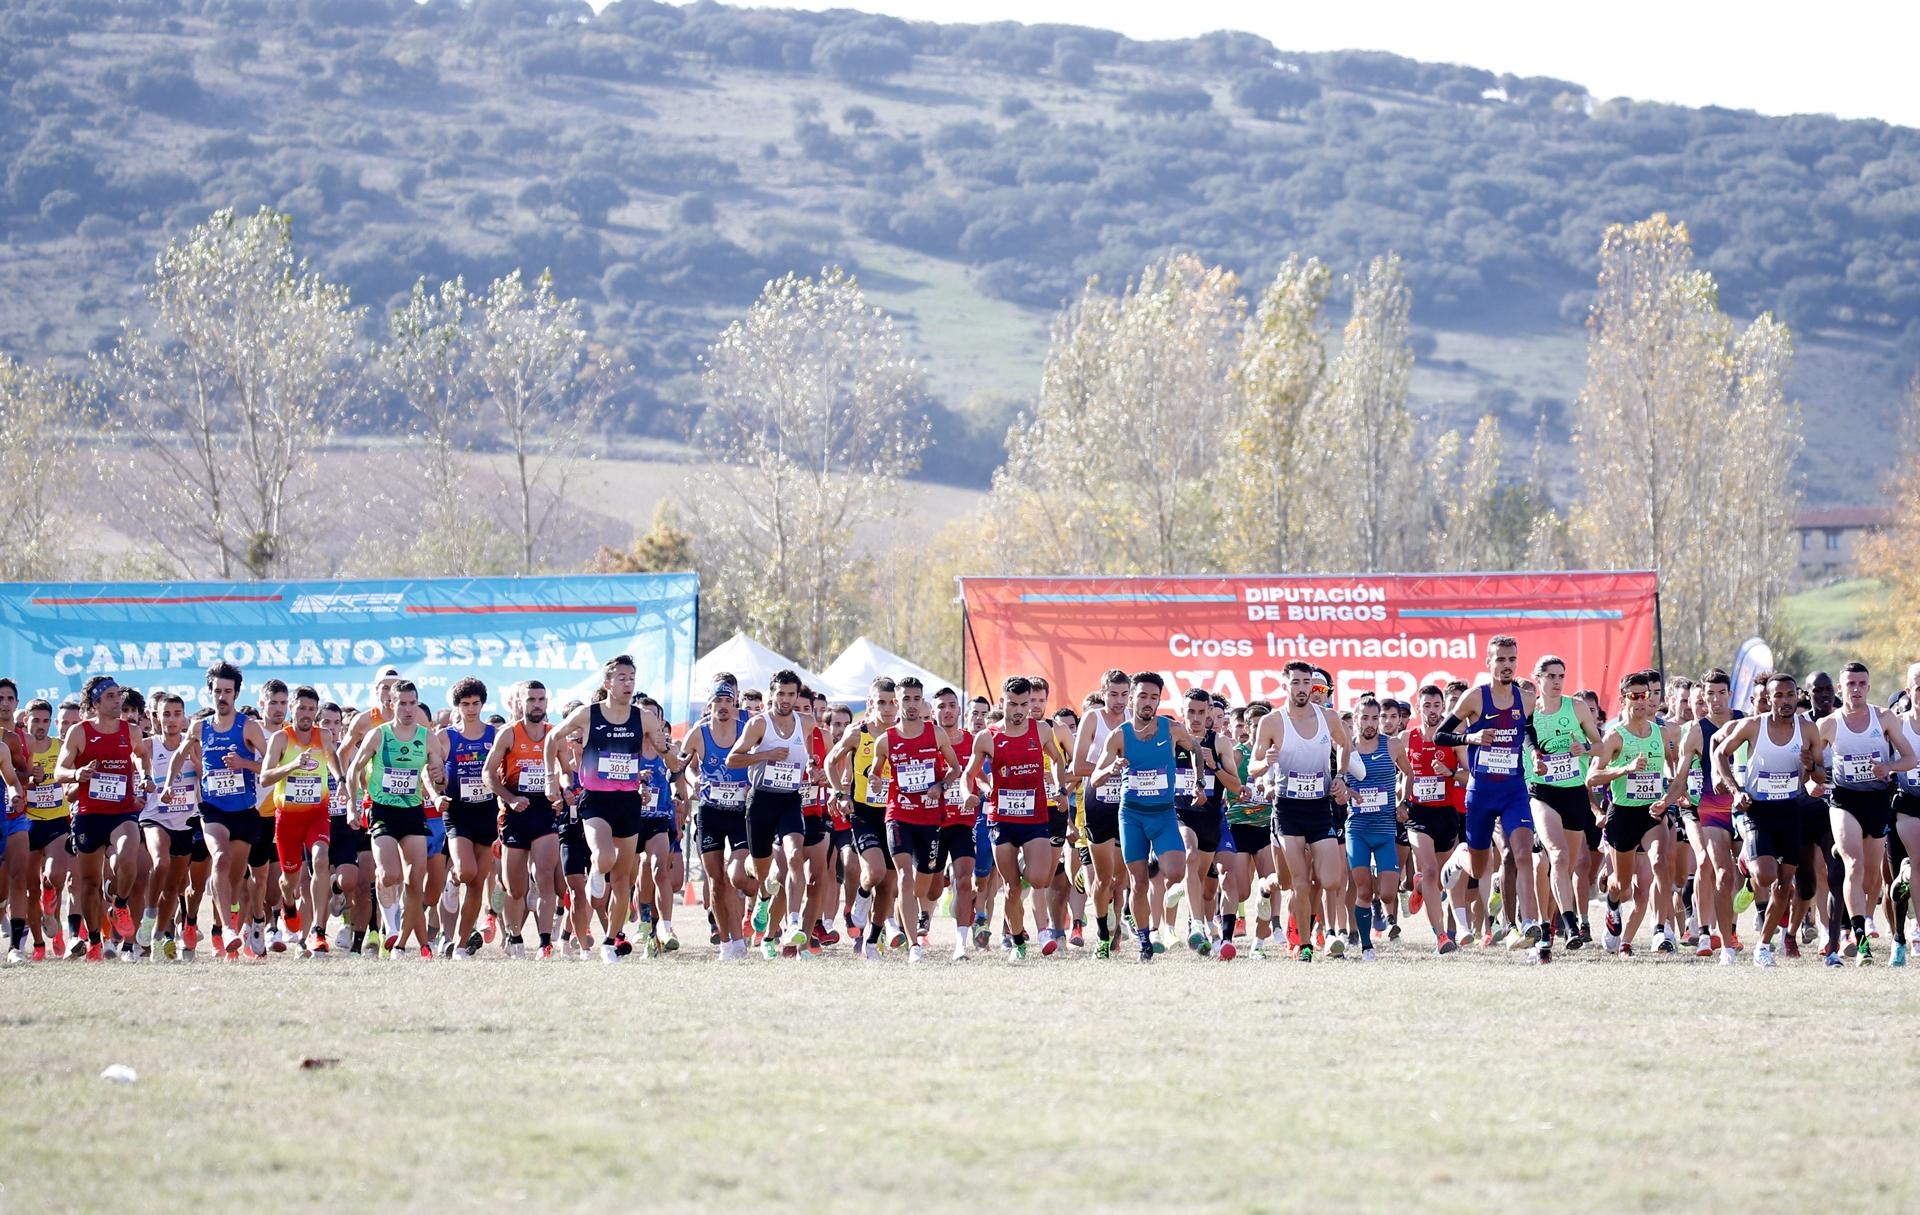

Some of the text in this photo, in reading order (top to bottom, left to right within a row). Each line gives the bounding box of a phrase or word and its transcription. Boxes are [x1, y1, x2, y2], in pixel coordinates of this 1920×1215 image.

[1245, 584, 1385, 603] DIPUTACIÓN
[1247, 605, 1387, 622] DE BURGOS
[1168, 632, 1476, 659] Cross Internacional
[54, 634, 599, 676] CAMPEONATO DE ESPAÑA
[418, 675, 448, 688] por
[36, 687, 59, 700] DE
[609, 763, 630, 773] 3035
[1013, 768, 1037, 776] LORCA
[1553, 764, 1572, 774] 203
[528, 778, 546, 786] 308
[774, 773, 792, 782] 146
[908, 776, 927, 784] 117
[217, 779, 235, 788] 219
[391, 780, 410, 788] 300
[1298, 784, 1316, 792] 143
[295, 788, 314, 797] 150
[472, 788, 484, 796] 81
[1136, 789, 1160, 797] Joma
[1420, 787, 1437, 795] 157
[1636, 784, 1654, 793] 204
[1766, 792, 1790, 800] Joma
[1008, 801, 1026, 809] 164
